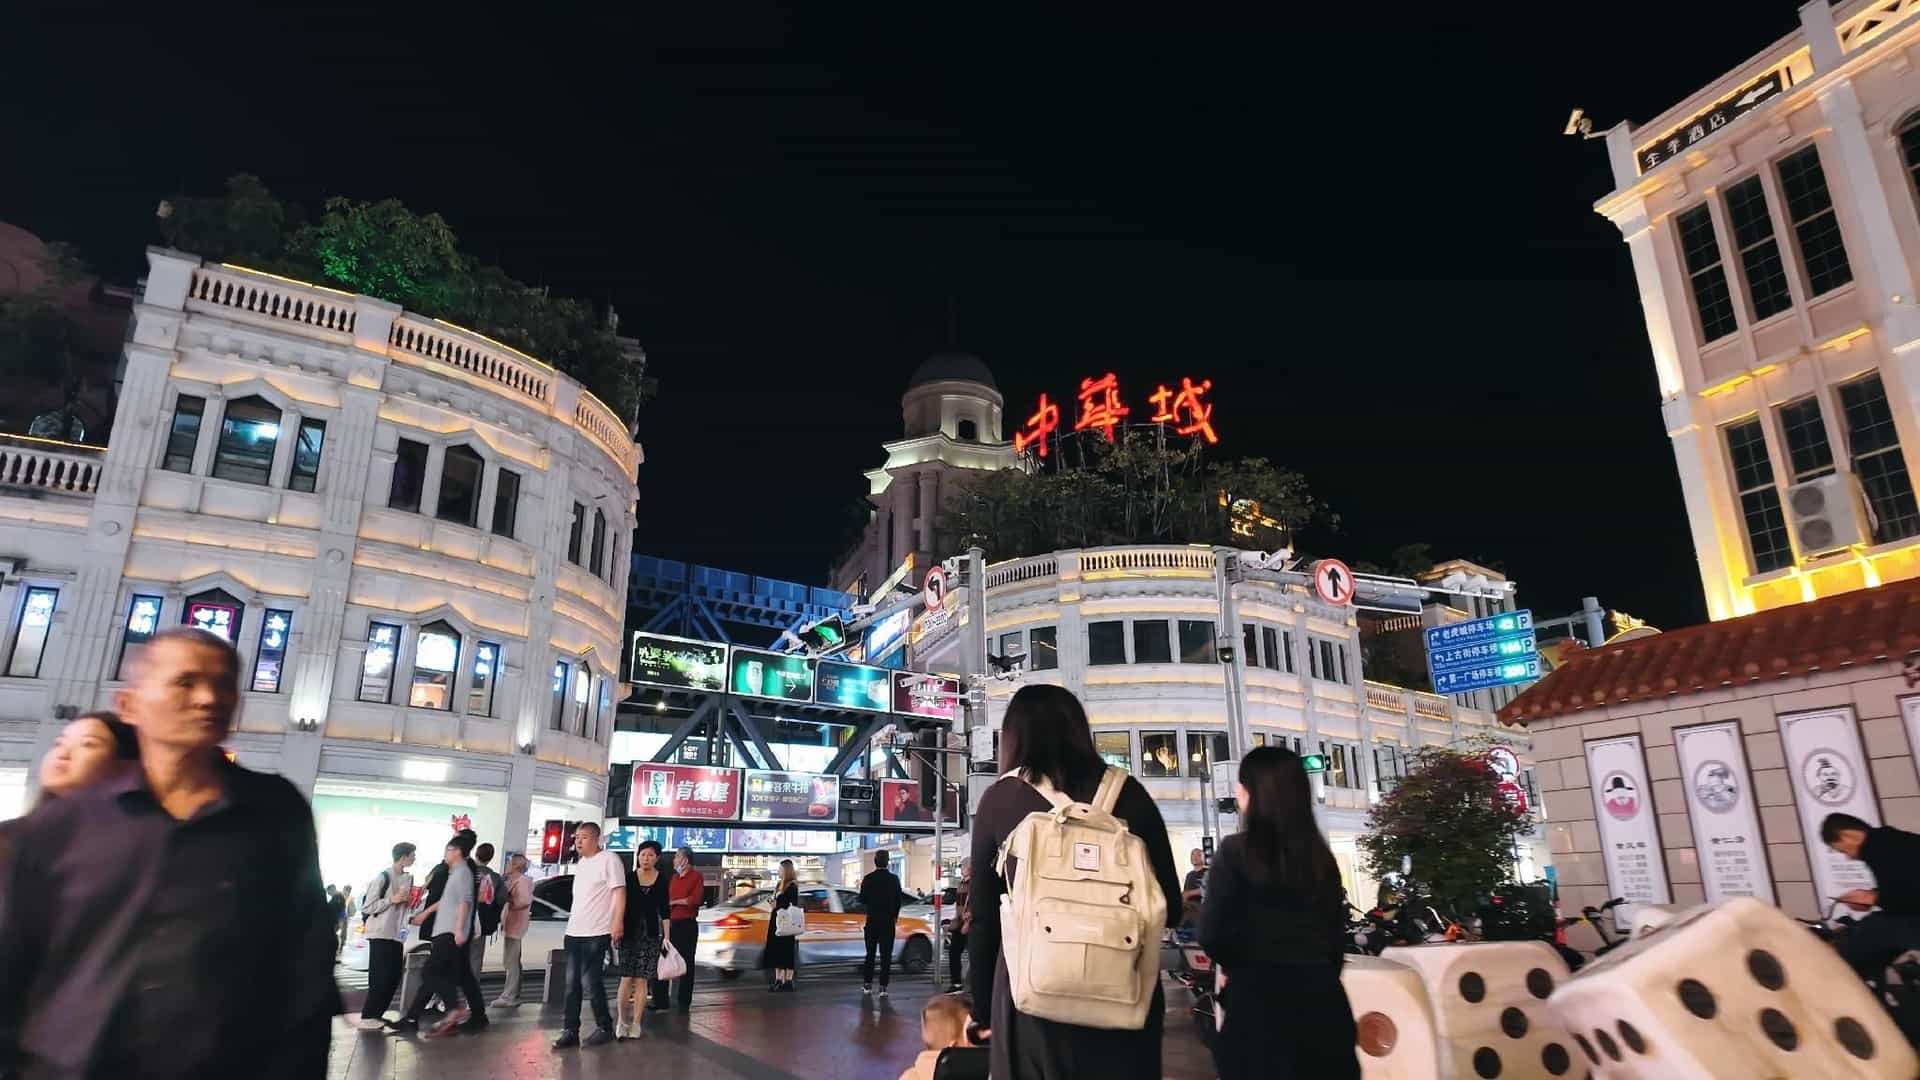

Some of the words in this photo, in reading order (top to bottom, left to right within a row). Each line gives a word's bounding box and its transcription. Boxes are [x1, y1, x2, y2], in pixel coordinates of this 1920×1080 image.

[1645, 111, 1726, 168] 全季酒店
[1520, 616, 1528, 628] P
[1524, 639, 1532, 651] P
[1528, 663, 1537, 674] P
[676, 779, 730, 802] 肯德基
